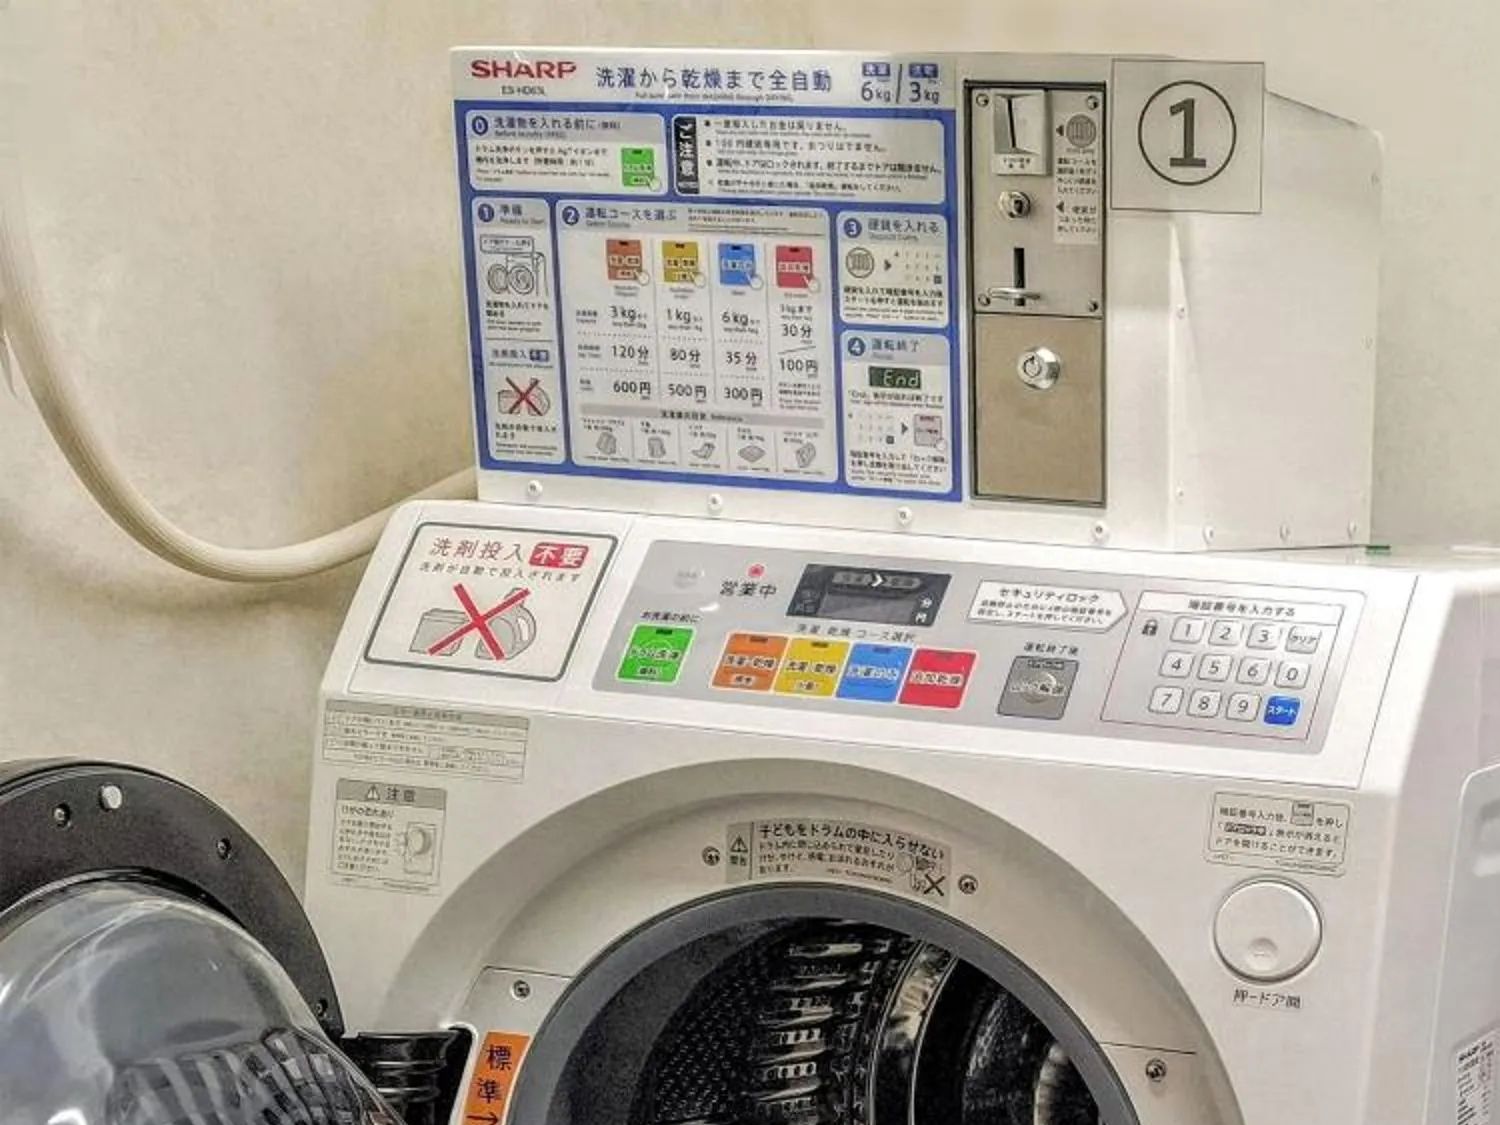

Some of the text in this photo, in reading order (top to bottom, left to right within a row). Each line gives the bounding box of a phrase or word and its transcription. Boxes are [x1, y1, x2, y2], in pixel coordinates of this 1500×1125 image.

[470, 59, 577, 79] SHARP
[596, 66, 833, 93] 洗濯から乾燥まで全自動
[429, 536, 587, 568] 洗剤投入 不要
[419, 561, 582, 583] 洗剤が自動で投入されます
[719, 579, 778, 598] 営業中
[999, 588, 1100, 604] セキュリティロック
[1184, 623, 1192, 635] 1
[1219, 627, 1231, 640] 2
[1258, 629, 1271, 643] 3
[1291, 634, 1318, 646] クリア
[1171, 657, 1182, 671] 4
[1210, 660, 1221, 675] 5
[1247, 663, 1259, 678] 6
[1285, 667, 1298, 681] 0
[1161, 693, 1173, 707] 7
[1197, 696, 1209, 711] 8
[1237, 699, 1249, 713] 9
[1267, 703, 1297, 716] スタート
[477, 1043, 513, 1103] 標準
